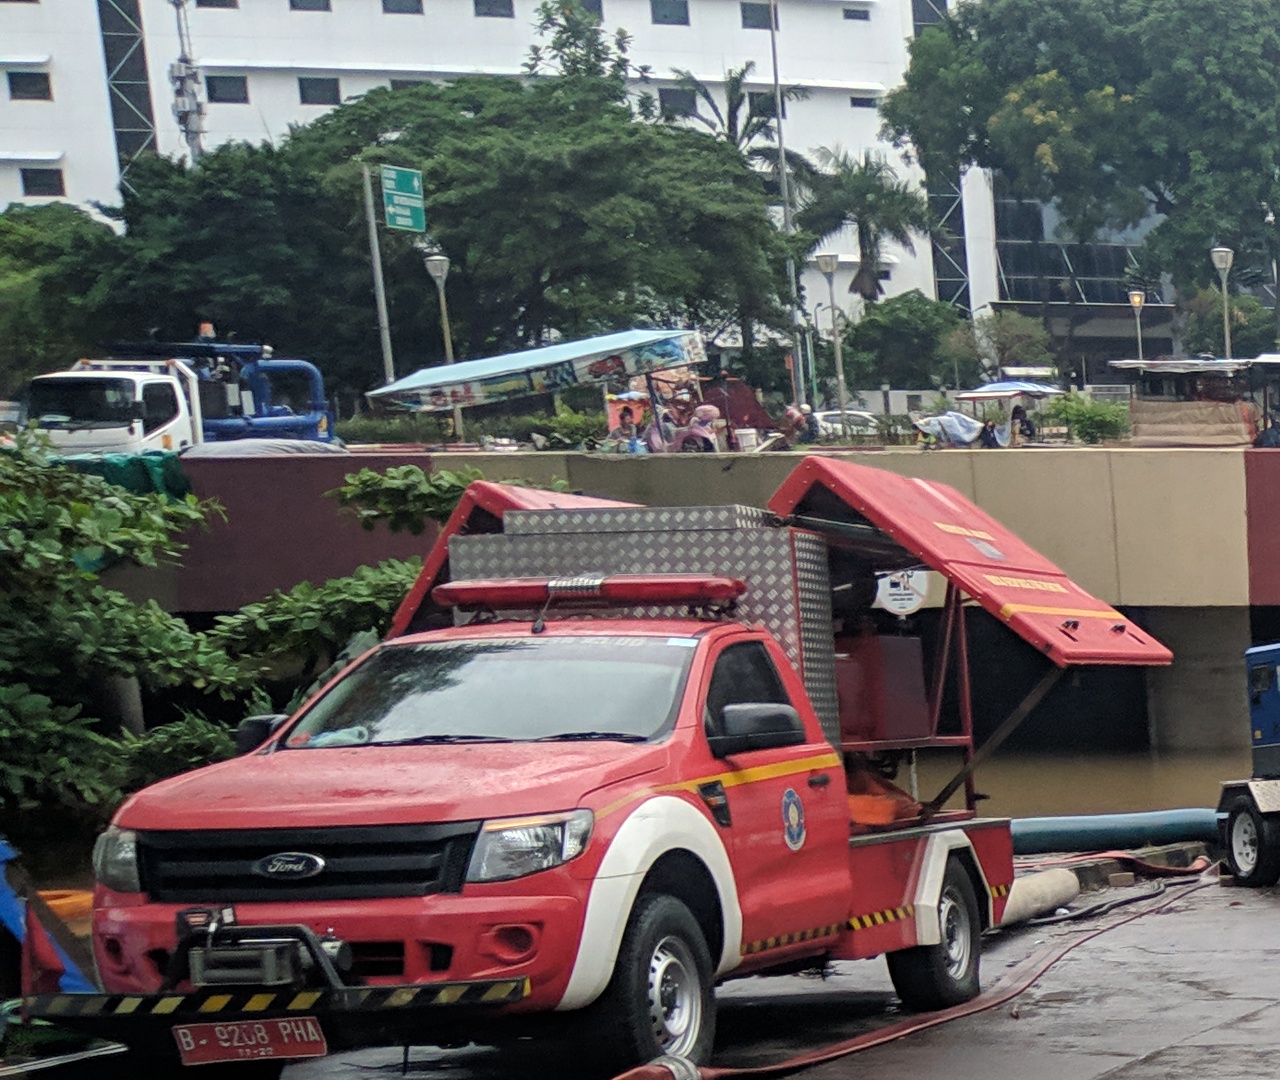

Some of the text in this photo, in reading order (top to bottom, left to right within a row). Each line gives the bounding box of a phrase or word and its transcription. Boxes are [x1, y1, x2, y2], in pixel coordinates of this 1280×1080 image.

[267, 857, 306, 873] Ford
[177, 1028, 195, 1051] B
[277, 1020, 321, 1044] PHA
